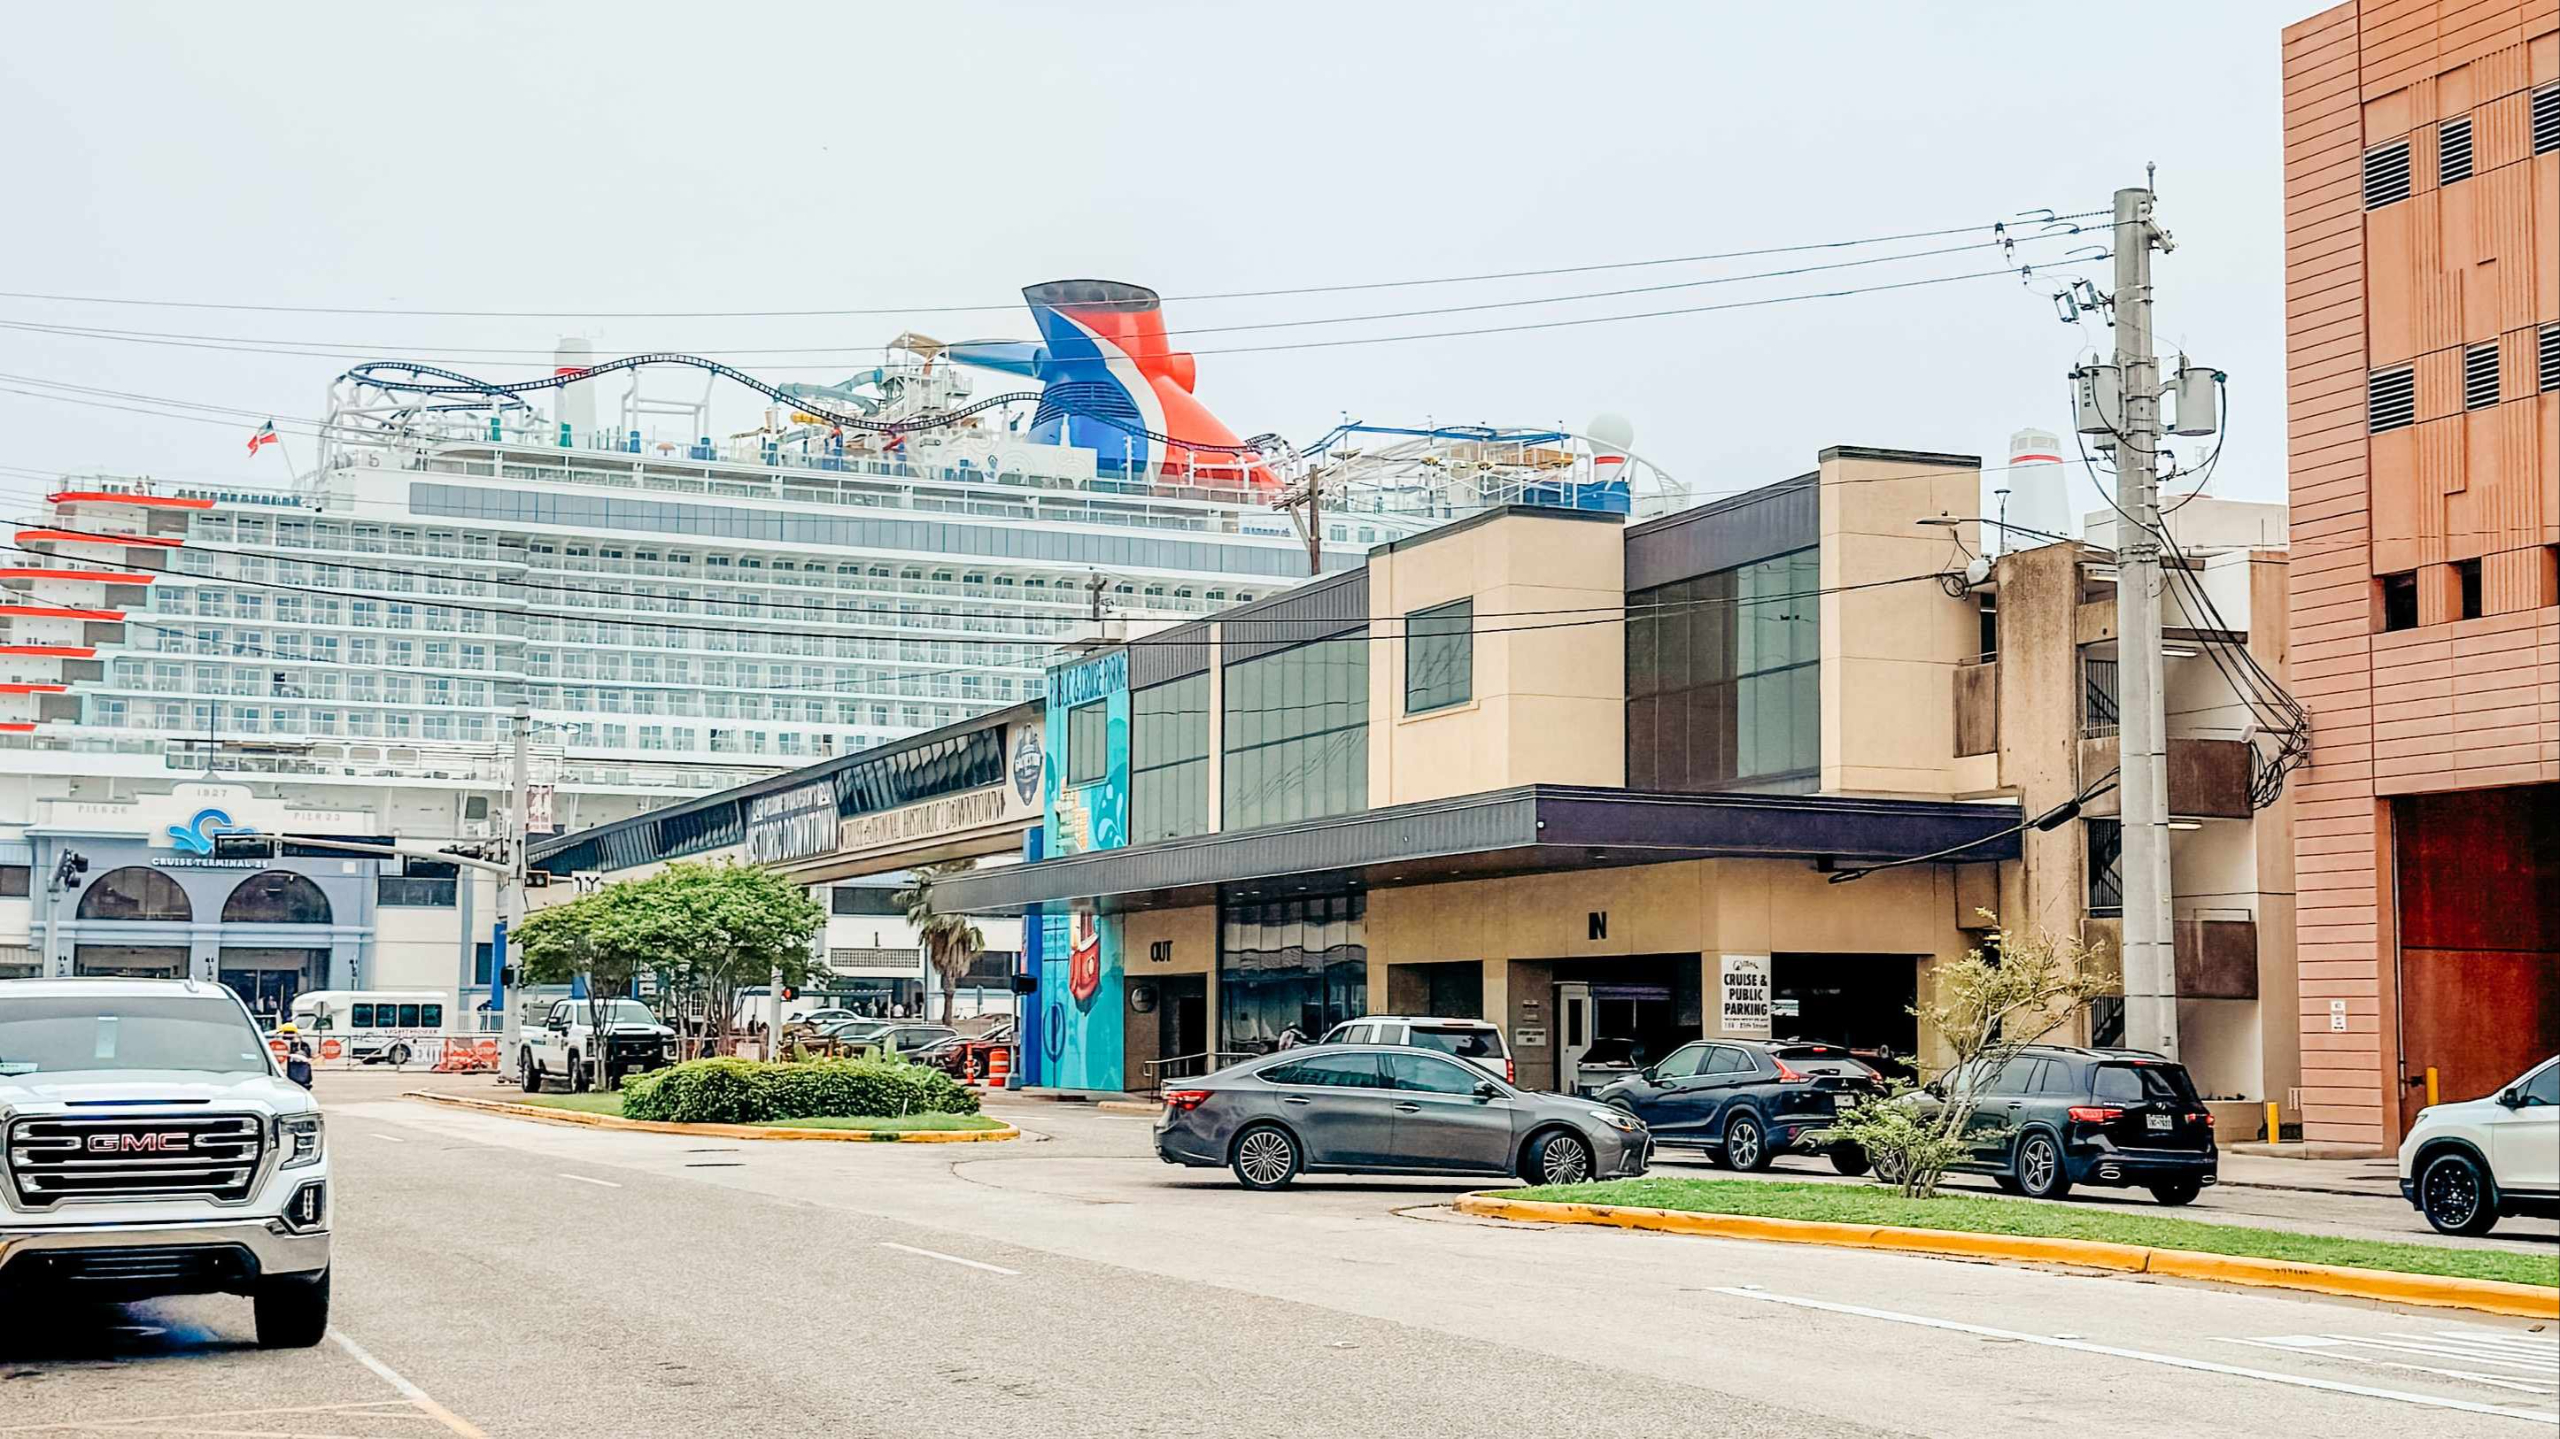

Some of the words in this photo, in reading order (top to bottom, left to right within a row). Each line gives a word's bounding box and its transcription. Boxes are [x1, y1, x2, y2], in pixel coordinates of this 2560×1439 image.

[746, 821, 783, 865] HISTORIC
[783, 806, 837, 859] DOWNTOWN
[151, 857, 192, 867] CRUISE
[193, 858, 250, 868] TERMINAL
[1150, 940, 1174, 963] OUT
[1724, 973, 1757, 986] CRUISE
[1760, 974, 1768, 987] &
[1729, 987, 1763, 1001] PUBLIC
[1724, 1002, 1768, 1016] PARKING
[414, 1045, 441, 1063] EXIT
[87, 1132, 189, 1153] GMC
